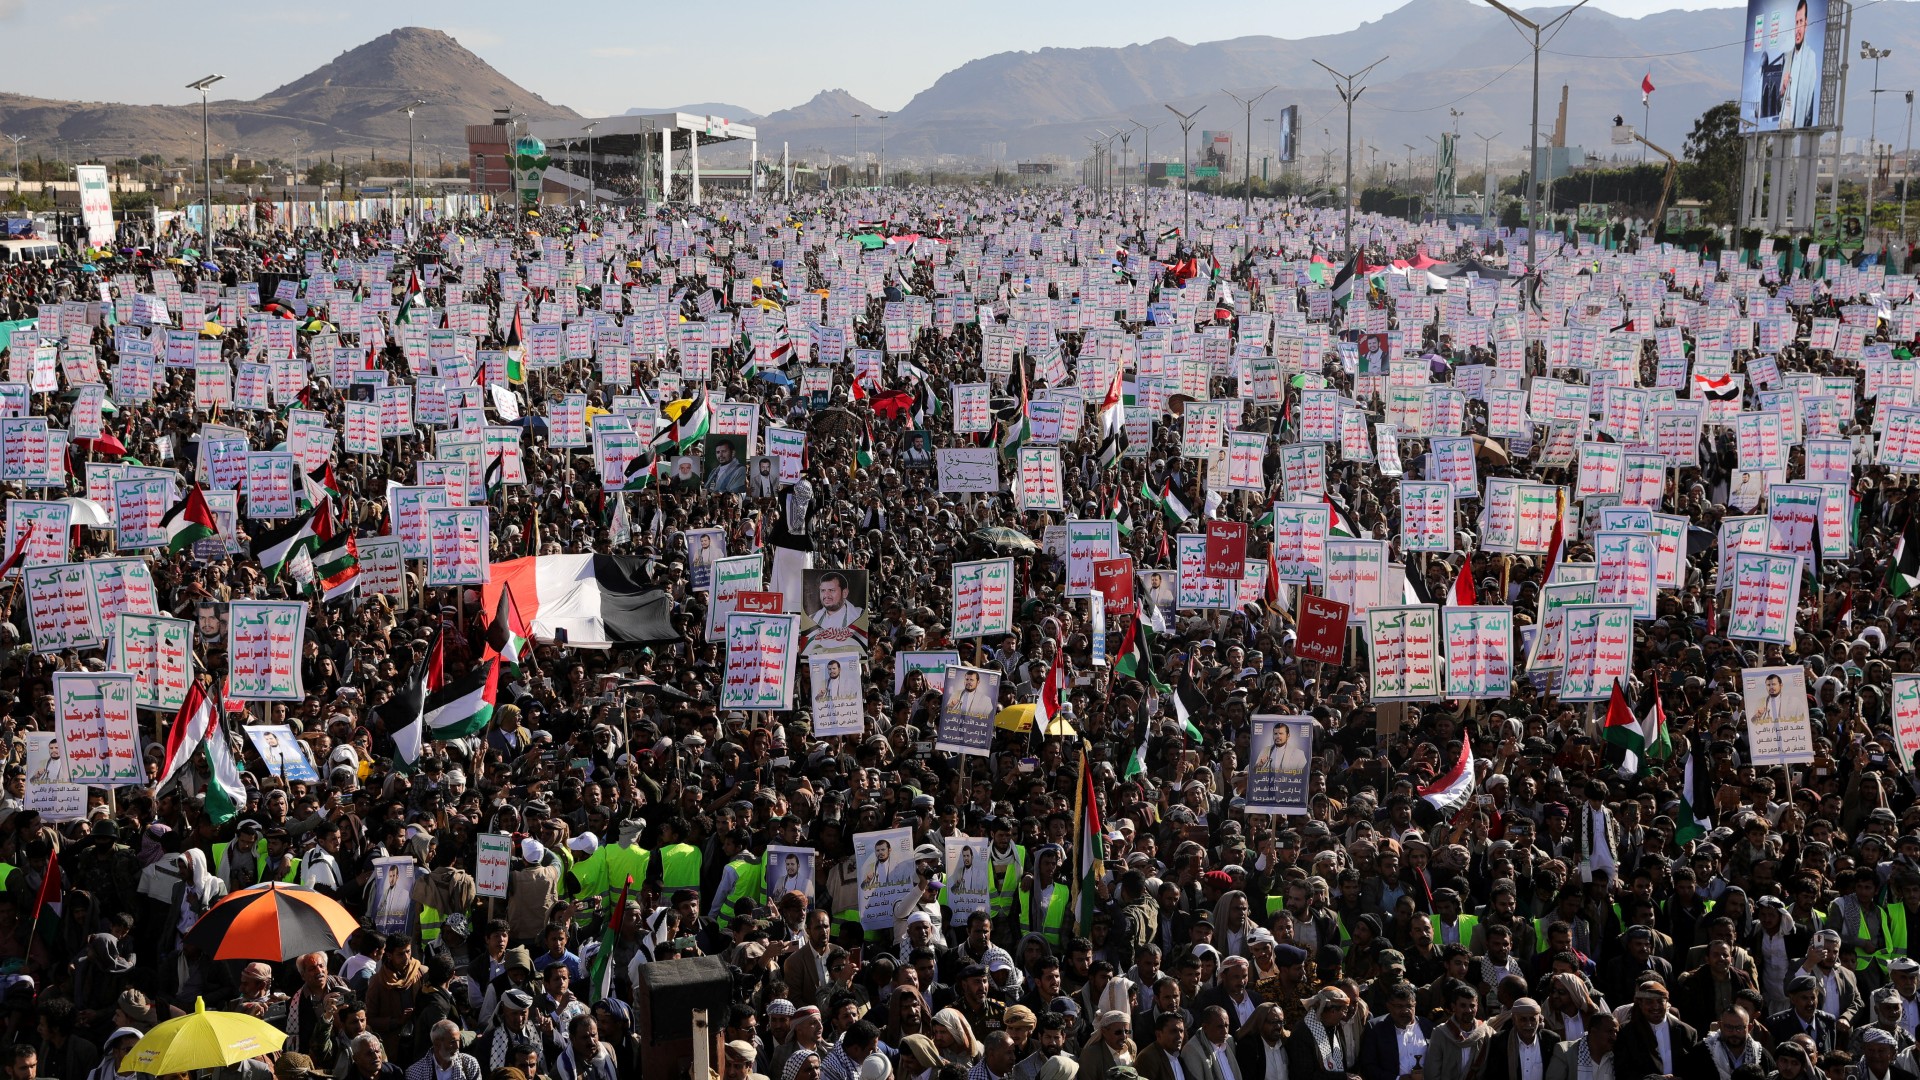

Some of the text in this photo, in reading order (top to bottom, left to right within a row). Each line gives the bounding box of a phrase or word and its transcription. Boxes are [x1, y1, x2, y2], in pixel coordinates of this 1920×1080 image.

[1584, 447, 1618, 459] قاطعوا
[252, 458, 290, 470] الله أكبر
[251, 471, 270, 480] لأمريكا
[252, 494, 266, 502] اليهود
[1773, 491, 1817, 506] قاطعوا
[251, 503, 291, 516] النصر للإسلام
[1071, 528, 1110, 545] قاطعوا
[1212, 526, 1241, 540] أمريكا
[1222, 545, 1229, 556] أم
[1099, 563, 1127, 577] أمريكا
[1210, 561, 1240, 576] الإرهاب
[1740, 557, 1791, 576] الله أكبر
[32, 567, 85, 588] الله أكبر
[959, 566, 1006, 584] الله أكبر
[957, 584, 1005, 596] الموت لأمريكا
[1110, 583, 1118, 592] أم
[1740, 577, 1789, 589] الموت لأمريكا
[33, 587, 85, 600] الموت لأمريكا
[1738, 592, 1786, 605] الموت لإسرائيل
[35, 601, 87, 617] الموت لإسرائيل
[743, 596, 777, 611] أمريكا
[958, 597, 1004, 611] الموت لإسرائيل
[957, 611, 973, 622] اليهود
[976, 610, 985, 619] على
[1307, 603, 1342, 620] أمريكا
[1736, 606, 1784, 619] اللعنة على اليهود
[37, 615, 90, 630] اللعنة على اليهود
[236, 610, 296, 629] الله أكبر
[1376, 612, 1431, 633] الله أكبر
[1449, 615, 1506, 635] الله أكبر
[1570, 611, 1628, 632] الله أكبر
[1733, 618, 1783, 635] النصر للإسلام
[732, 619, 787, 640] الله أكبر
[955, 619, 1003, 635] النصر للإسلام
[1318, 625, 1327, 636] أم
[38, 627, 94, 646] النصر للإسلام
[236, 631, 293, 642] الموت لأمريكا
[1375, 633, 1431, 645] الموت لأمريكا
[1451, 636, 1506, 646] الموت لأمريكا
[1570, 632, 1625, 644] الموت لأمريكا
[730, 641, 785, 653] الموت لأمريكا
[1302, 640, 1337, 657] الإرهاب
[235, 647, 292, 662] الموت لإسرائيل
[1377, 649, 1431, 662] الموت لإسرائيل
[1451, 650, 1506, 663] الموت لإسرائيل
[1569, 648, 1625, 662] الموت لإسرائيل
[234, 664, 292, 677] اللعنة على اليهود
[729, 658, 784, 671] الموت لإسرائيل
[1377, 664, 1432, 676] اللعنة على اليهود
[1451, 666, 1507, 678] اللعنة على اليهود
[1567, 666, 1623, 678] اللعنة على اليهود
[234, 679, 292, 694] النصر للإسلام
[727, 675, 747, 686] اليهود
[749, 674, 761, 686] على
[764, 675, 782, 685] اللعنة
[1377, 677, 1434, 694] النصر للإسلام
[1451, 678, 1508, 694] النصر للإسلام
[1564, 679, 1594, 695] للإسلام
[64, 681, 129, 706] الله أكبر
[725, 689, 781, 705] النصر للإسلام
[64, 706, 128, 722] الموت لأمريكا
[67, 727, 131, 742] الموت لإسرائيل
[70, 745, 134, 760] اللعنة على اليهود
[71, 763, 139, 780] النصر للإسلام
[480, 839, 508, 853] قاطعوا
